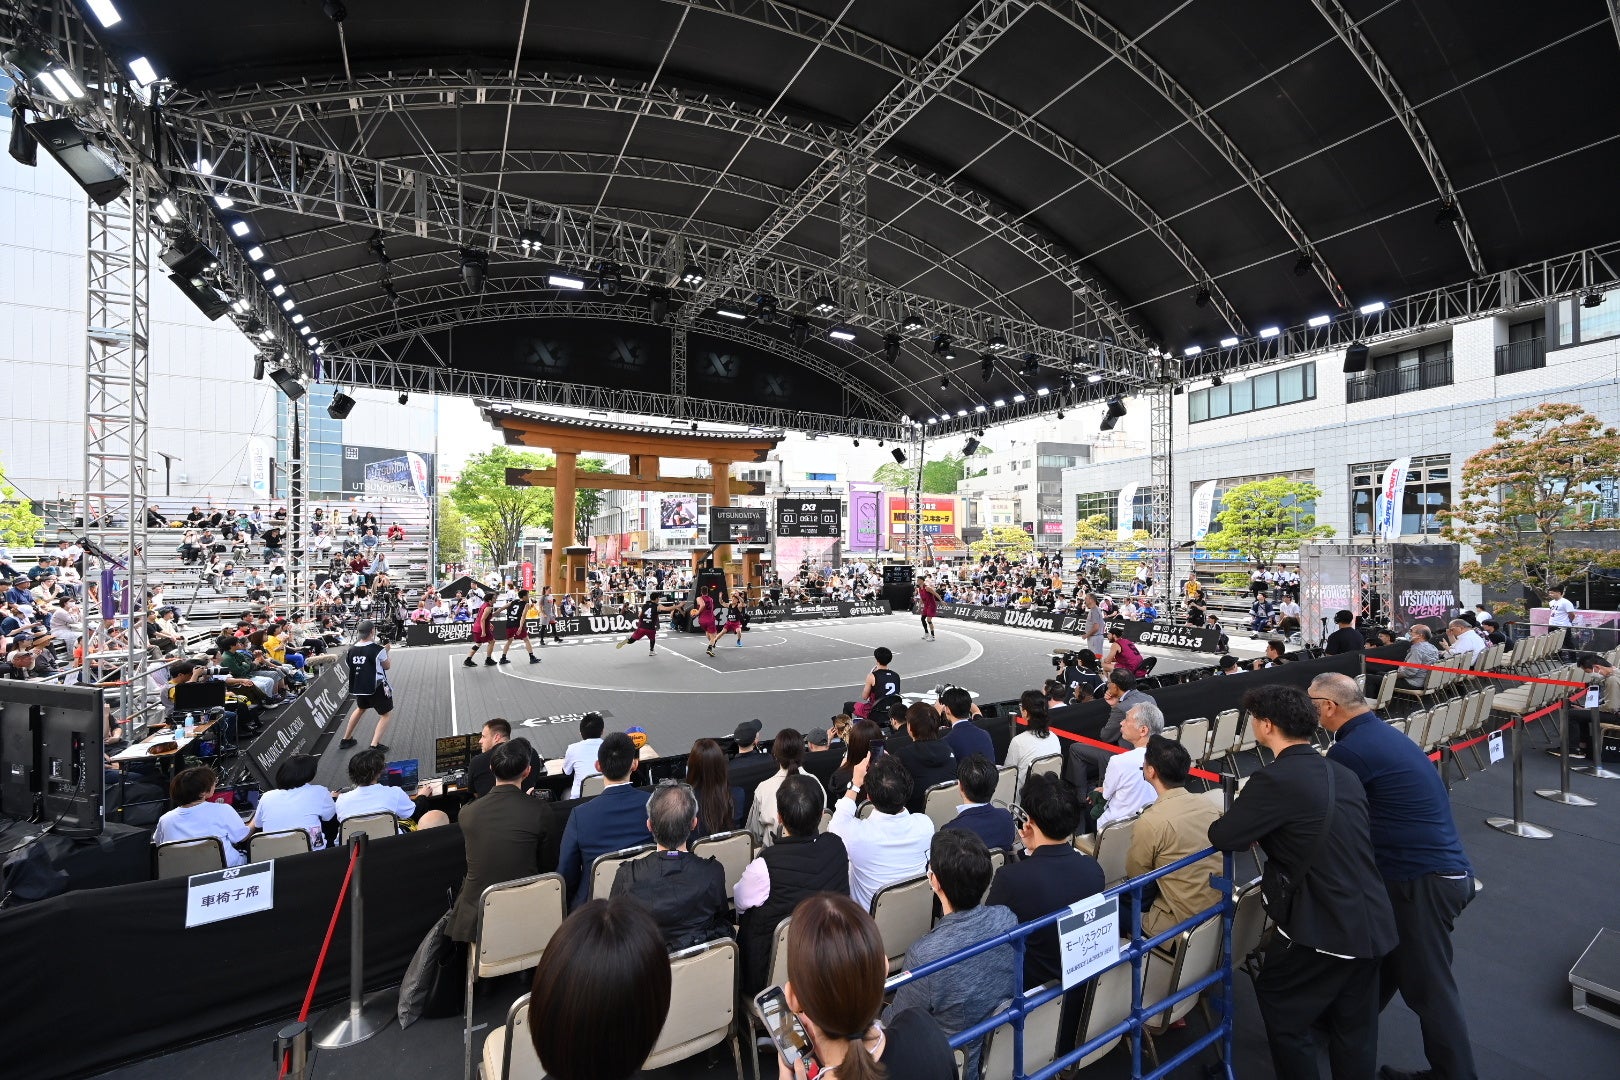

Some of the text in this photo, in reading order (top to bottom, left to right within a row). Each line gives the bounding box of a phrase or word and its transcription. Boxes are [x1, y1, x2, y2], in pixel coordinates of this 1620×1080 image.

[784, 514, 794, 523] 01
[824, 515, 834, 523] 01
[1399, 594, 1455, 607] UTSUNOMIYA
[511, 605, 519, 615] 3
[644, 608, 652, 618] 4
[954, 606, 970, 617] IHI
[1004, 609, 1053, 630] Wilson
[1139, 630, 1203, 648] @FIBA3x3
[885, 682, 896, 695] 2
[313, 688, 337, 719] TKC
[257, 739, 282, 771] MAURICE
[201, 885, 260, 907] 車椅子席
[1066, 922, 1113, 952] モーリスラクロア
[1081, 940, 1099, 956] シート
